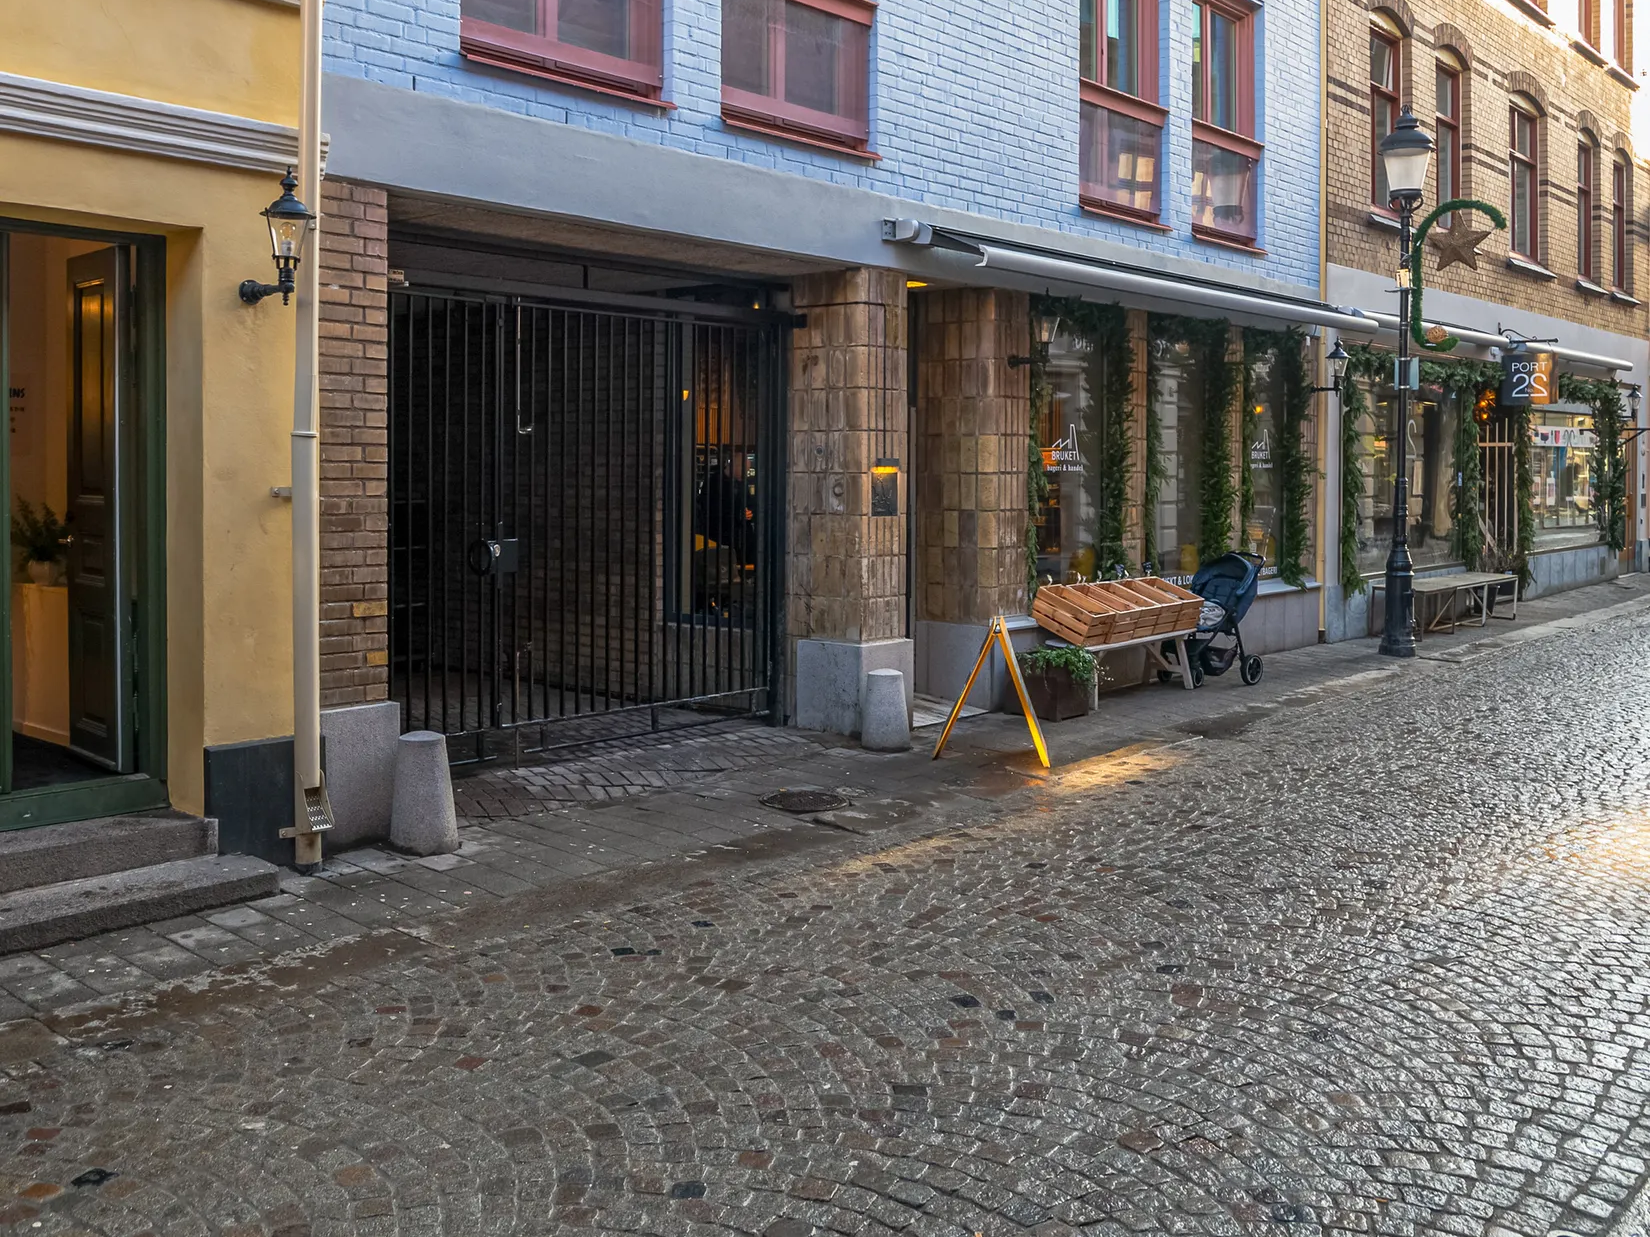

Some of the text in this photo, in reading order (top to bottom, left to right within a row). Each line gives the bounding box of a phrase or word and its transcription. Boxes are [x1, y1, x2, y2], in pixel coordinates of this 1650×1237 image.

[1511, 362, 1548, 372] PORT
[1051, 450, 1077, 461] BRUKET
[1177, 575, 1182, 585] &
